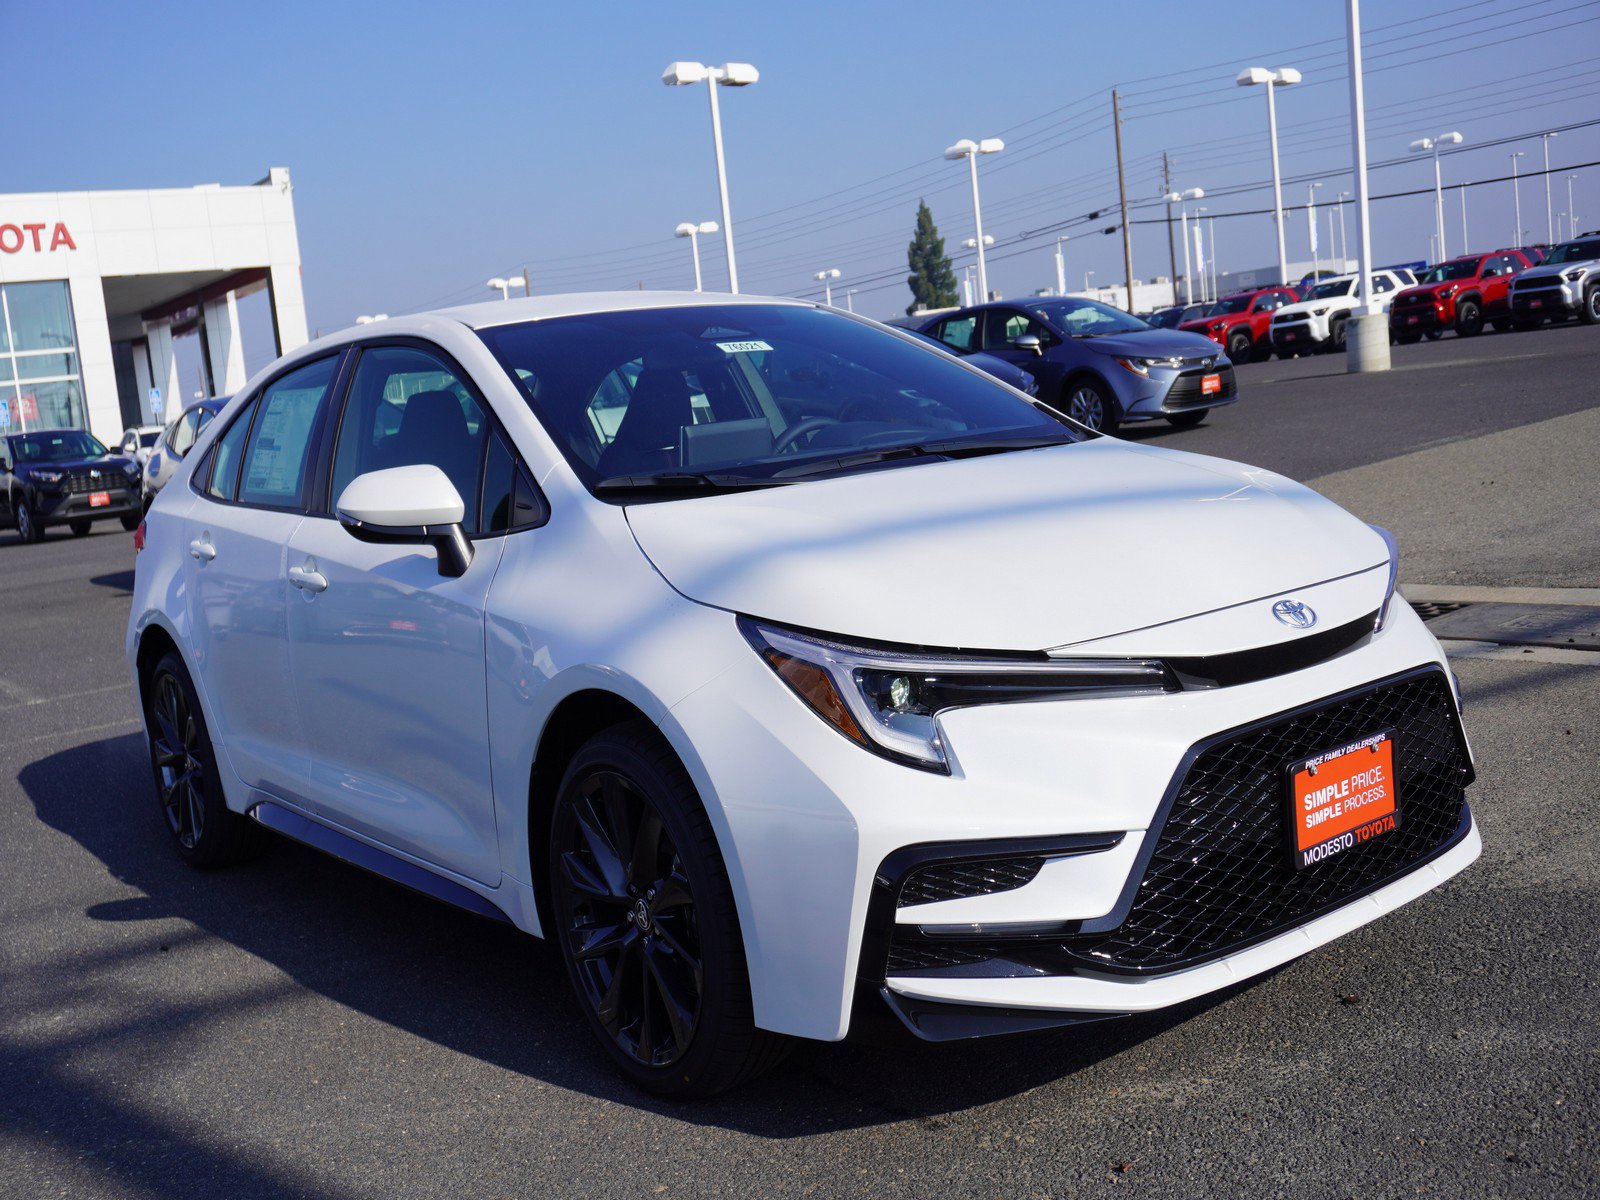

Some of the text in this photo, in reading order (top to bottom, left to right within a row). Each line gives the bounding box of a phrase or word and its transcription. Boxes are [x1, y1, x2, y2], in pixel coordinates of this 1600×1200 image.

[724, 342, 763, 351] 76021
[1305, 733, 1385, 769] PRICE FAMILY DEALERSHIPS
[1304, 765, 1385, 811] SIMPLE PRICE.
[1305, 785, 1387, 828] SIMPLE PROCESS.
[1304, 816, 1395, 866] MODESTO TOYOTA
